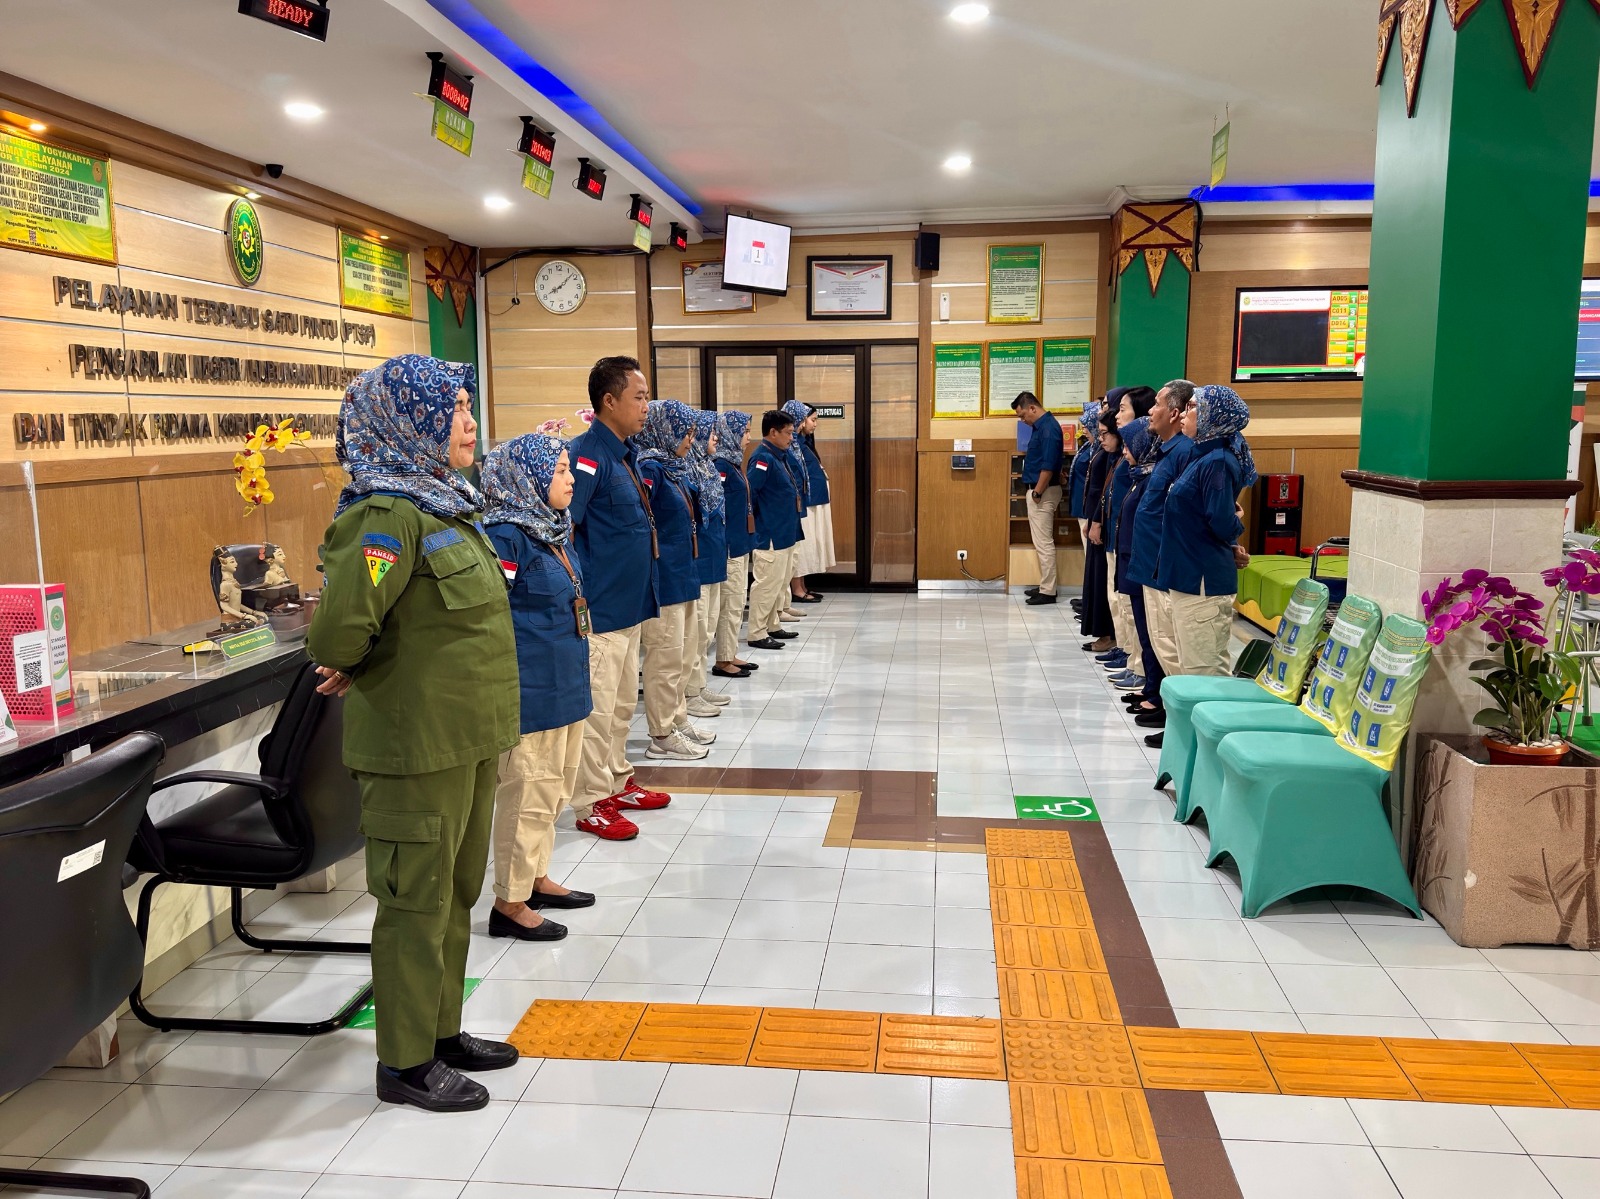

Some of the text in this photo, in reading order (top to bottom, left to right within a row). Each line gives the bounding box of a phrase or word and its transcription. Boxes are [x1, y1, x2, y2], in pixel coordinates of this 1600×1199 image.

[268, 0, 313, 27] READY
[26, 151, 73, 171] PELAYANAN
[42, 145, 91, 166] YOGYAKARTA
[50, 165, 70, 176] 2024
[53, 276, 178, 320] PELAYANAN
[260, 309, 299, 336] SATU
[13, 413, 65, 443] DAN
[370, 560, 387, 573] P S
